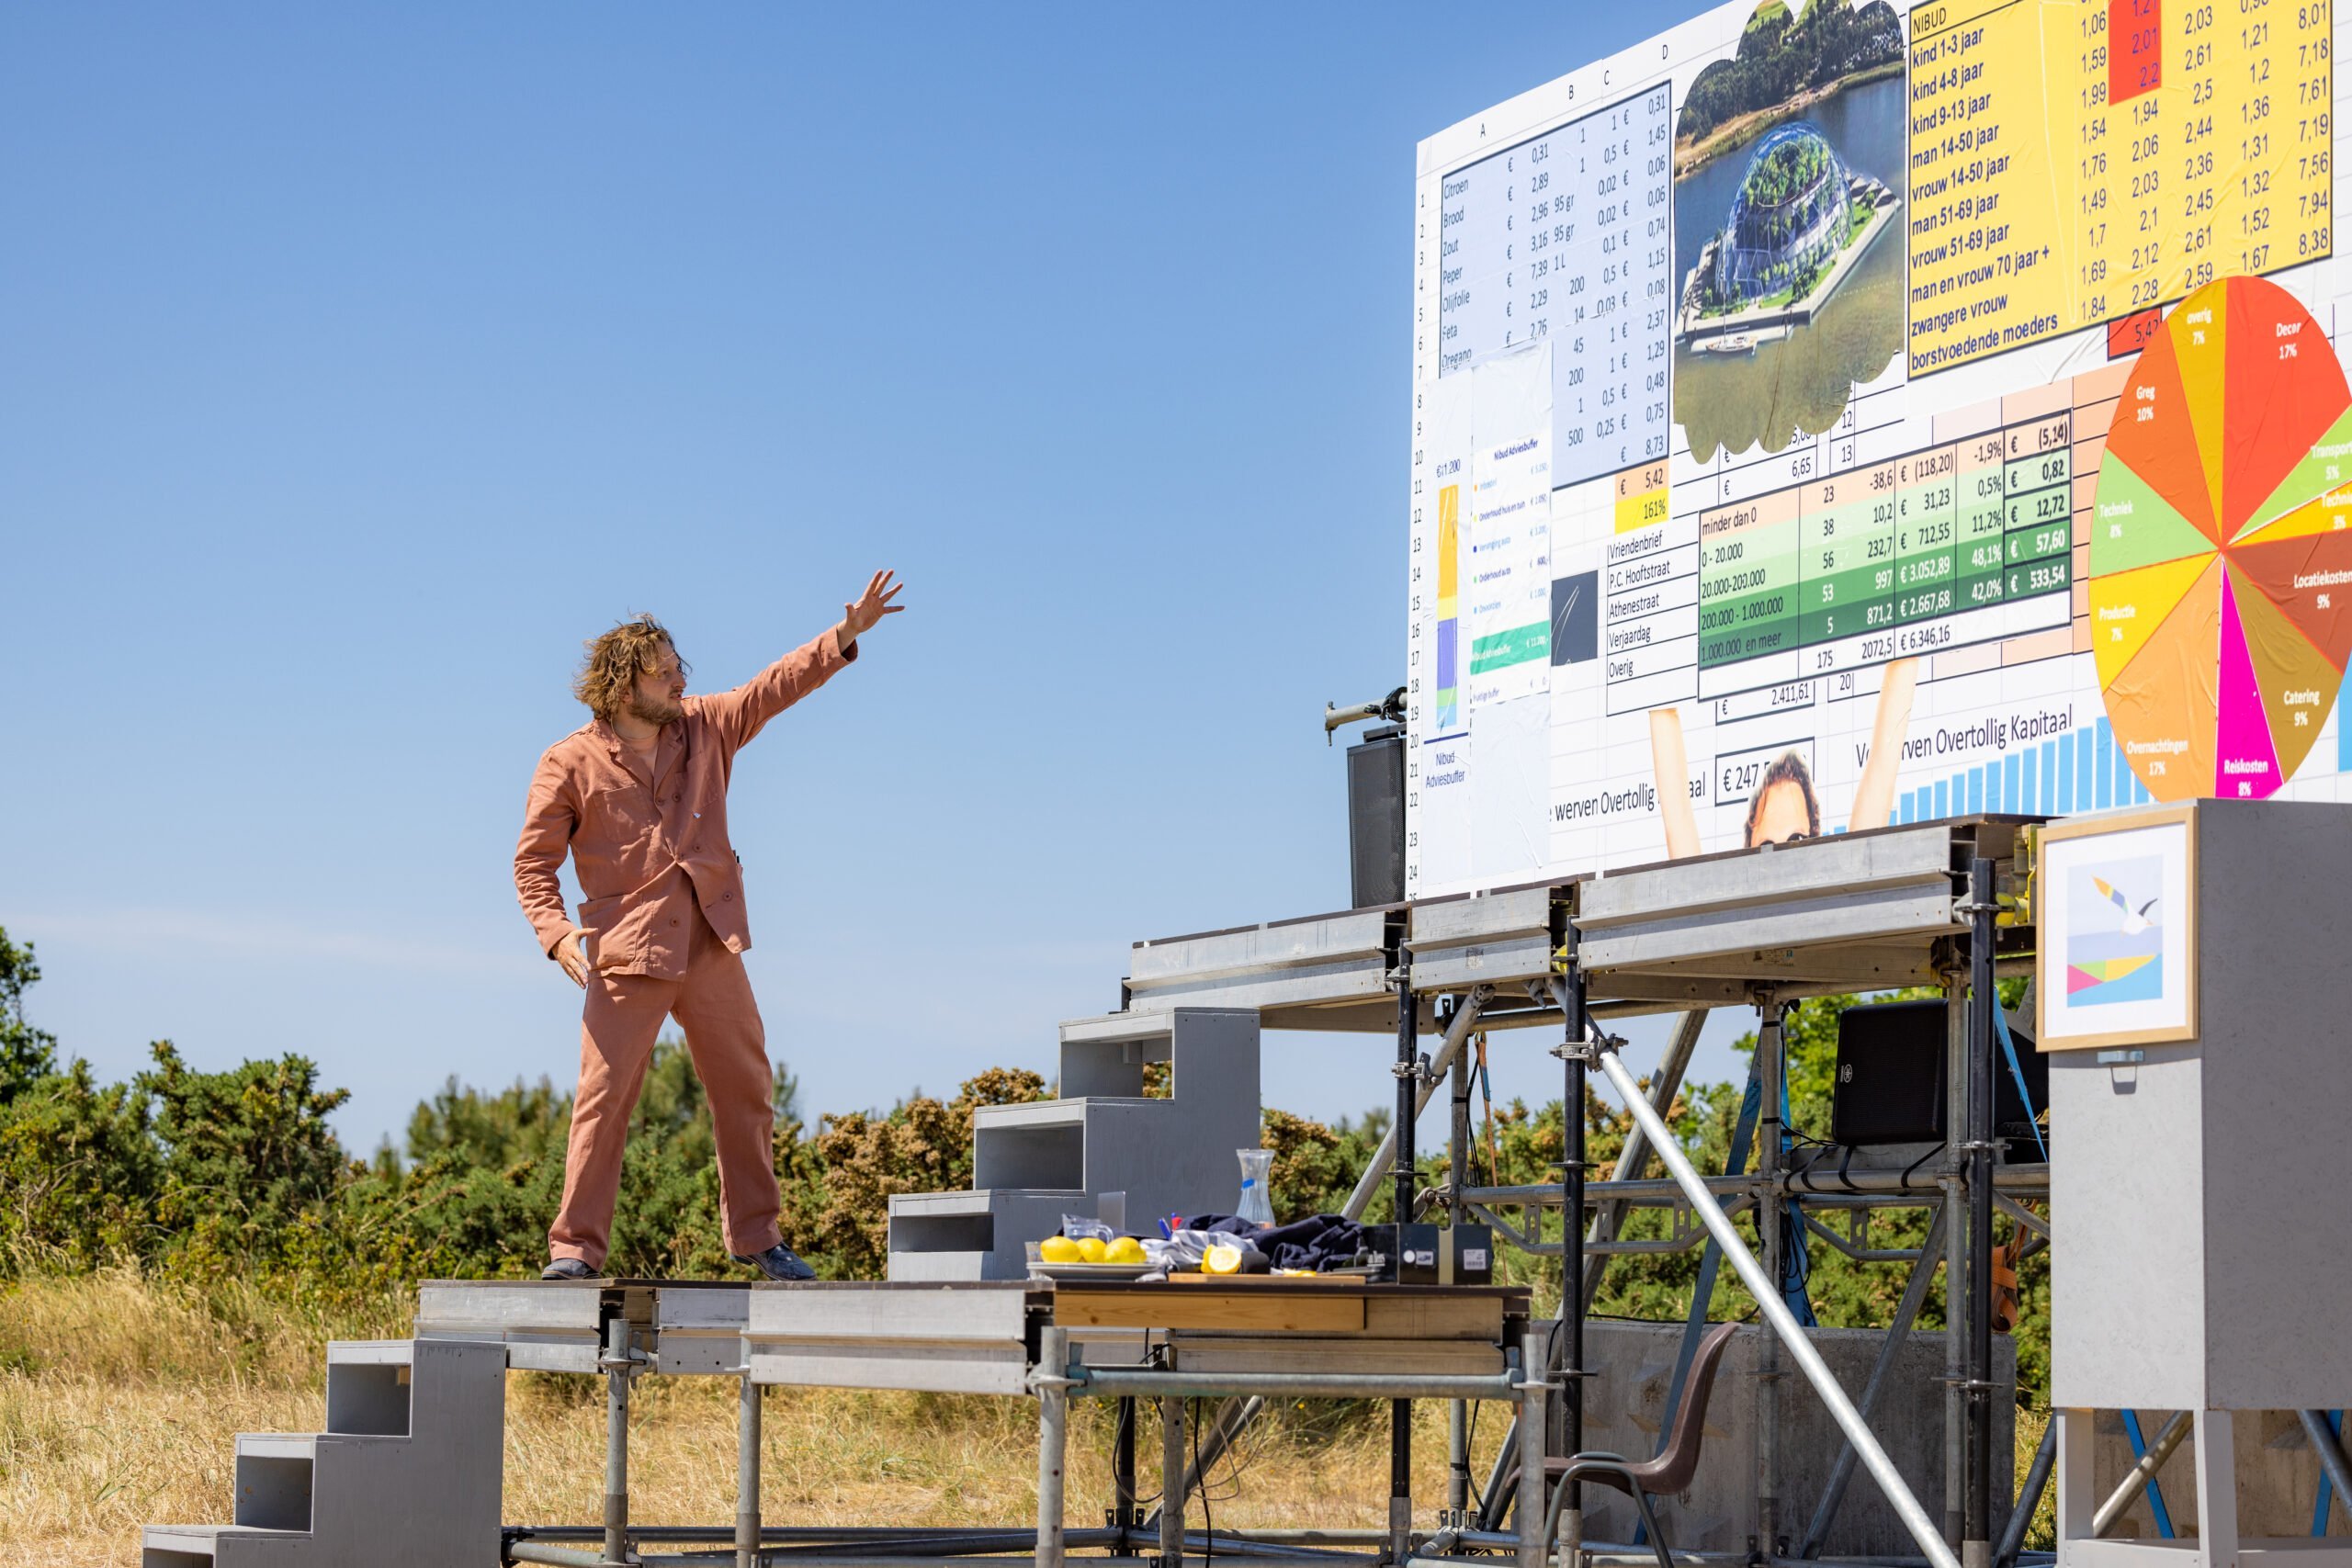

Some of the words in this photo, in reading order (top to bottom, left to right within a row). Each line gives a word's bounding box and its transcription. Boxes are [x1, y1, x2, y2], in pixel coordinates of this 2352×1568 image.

[1913, 7, 1947, 36] NIBUD
[2082, 11, 2107, 39] 1,06
[2185, 6, 2213, 35] 2,03
[2299, 2, 2327, 30] 8,01
[1663, 44, 1668, 60] D
[1913, 42, 1937, 69] kind
[1940, 35, 1958, 57] 1-3
[1961, 28, 1984, 55] jaar
[2299, 39, 2328, 68] 7,18
[1604, 70, 1610, 85] C
[1913, 75, 1937, 102] kind
[1939, 68, 1958, 91] 4-8
[1961, 62, 1984, 89] jaar
[1568, 85, 1574, 100] B
[1913, 110, 1937, 136] kind
[1939, 99, 1964, 125] 9-13
[1968, 94, 1991, 120] jaar
[2133, 98, 2159, 126] 1,94
[2242, 96, 2270, 125] 1,36
[1480, 123, 1486, 138] A
[1648, 125, 1666, 147] 1,45
[2082, 118, 2107, 145] 1,54
[2185, 116, 2213, 144] 2,44
[1532, 143, 1548, 164] 0,31
[1913, 147, 1938, 169] man
[1941, 130, 1973, 156] 14-50
[1975, 125, 1999, 152] jaar
[1444, 178, 1469, 199] Citroen
[1913, 176, 1948, 201] vrouw
[1951, 161, 1983, 186] 14-50
[1986, 155, 2010, 182] jaar
[1913, 214, 1938, 236] man
[1940, 198, 1973, 227] 51-69
[1975, 193, 1999, 220] jaar
[2185, 188, 2213, 218] 2,45
[2299, 189, 2328, 219] 7,94
[1444, 206, 1464, 228] Brood
[1648, 218, 1665, 239] 0,74
[1443, 240, 1458, 256] Zout
[1913, 244, 1948, 269] vrouw
[1951, 230, 1983, 257] 51-69
[1985, 224, 2010, 251] jaar
[2299, 228, 2328, 257] 8,38
[2132, 243, 2159, 272] 2,12
[2242, 244, 2270, 273] 1,67
[1442, 265, 1463, 286] Peper
[1531, 260, 1548, 280] 7,39
[1913, 282, 1938, 303] man
[1940, 276, 1954, 296] en
[1957, 263, 1995, 288] vrouw
[1997, 254, 2011, 276] 70
[2014, 248, 2039, 276] jaar
[2082, 259, 2107, 288] 1,69
[1647, 310, 1665, 332] 2,37
[1912, 306, 1967, 337] zwangere
[1971, 294, 2008, 320] vrouw
[2277, 321, 2302, 338] Decor
[1912, 330, 1999, 371] borstvoedende
[2003, 314, 2058, 344] moeders
[2278, 344, 2297, 360] 17%
[2137, 386, 2155, 400] Greg
[2137, 406, 2154, 422] 10%
[1568, 428, 1583, 446] 500
[1646, 435, 1664, 457] 8,73
[1841, 445, 1852, 464] 13
[1973, 440, 2002, 463] -1,9%
[1646, 468, 1663, 489] 5,42
[1792, 457, 1811, 479] 6,65
[1901, 466, 1906, 481] €
[1915, 452, 1954, 483] (118,20)
[2042, 459, 2064, 481] 0,82
[1870, 469, 1894, 491] -38,6
[1977, 474, 2002, 497] 0,5%
[1645, 500, 1666, 520] 161%
[1924, 488, 1950, 512] 31,23
[2037, 494, 2064, 518] 12,72
[2098, 500, 2133, 518] Techniek
[1702, 514, 1732, 536] minder
[1734, 511, 1749, 527] dan
[1751, 507, 1757, 523] 0
[1874, 503, 1893, 525] 10,2
[1972, 510, 2002, 533] 11,2%
[1823, 518, 1835, 536] 38
[1918, 522, 1950, 546] 712,55
[1610, 532, 1663, 559] Vriendenbrief
[1868, 536, 1893, 558] 232,7
[2036, 529, 2065, 554] 57,60
[1702, 551, 1707, 568] 0
[1715, 542, 1743, 565] 20.000
[1823, 551, 1834, 570] 56
[1972, 544, 2002, 567] 48,1%
[1610, 573, 1623, 589] P.C.
[1626, 560, 1670, 585] Hooftstraat
[1875, 570, 1893, 590] 997
[1900, 566, 1907, 584] €
[1909, 555, 1951, 581] 3.052,89
[2030, 566, 2065, 589] 533,54
[2293, 570, 2352, 589] Locatiekosten
[1972, 579, 2002, 601] 42,0%
[2317, 593, 2330, 609] 9%
[1610, 593, 1659, 619] Athenestraat
[1702, 610, 1735, 631] 200.000
[1742, 596, 1784, 622] 1.000.000
[1867, 604, 1893, 625] 871,2
[1900, 600, 1907, 617] €
[1909, 589, 1951, 615] 2.667,68
[2098, 604, 2136, 622] Productie
[1609, 626, 1651, 649] Verjaardag
[1702, 638, 1741, 662] 1.000.000
[1746, 637, 1757, 652] en
[1758, 631, 1781, 649] meer
[1861, 637, 1893, 660] 2072,5
[1900, 634, 1907, 651] €
[1909, 625, 1951, 649] 6.346,16
[1609, 659, 1634, 678] Overig
[1817, 650, 1833, 671] 175
[1771, 683, 1809, 706] 2.411,61
[2284, 688, 2320, 706] Catering
[1937, 718, 2006, 753] Overtollig
[2010, 704, 2072, 740] Kapitaal
[2294, 711, 2309, 727] 9%
[1436, 751, 1455, 766] Nibud
[2126, 739, 2188, 756] Overnachtingen
[2148, 761, 2165, 776] 17%
[2223, 759, 2268, 774] Reiskosten
[1426, 770, 1465, 788] Adviesbuffer
[1409, 793, 1419, 807] 22
[1555, 797, 1598, 822] werven
[1600, 783, 1655, 814] Overtollig
